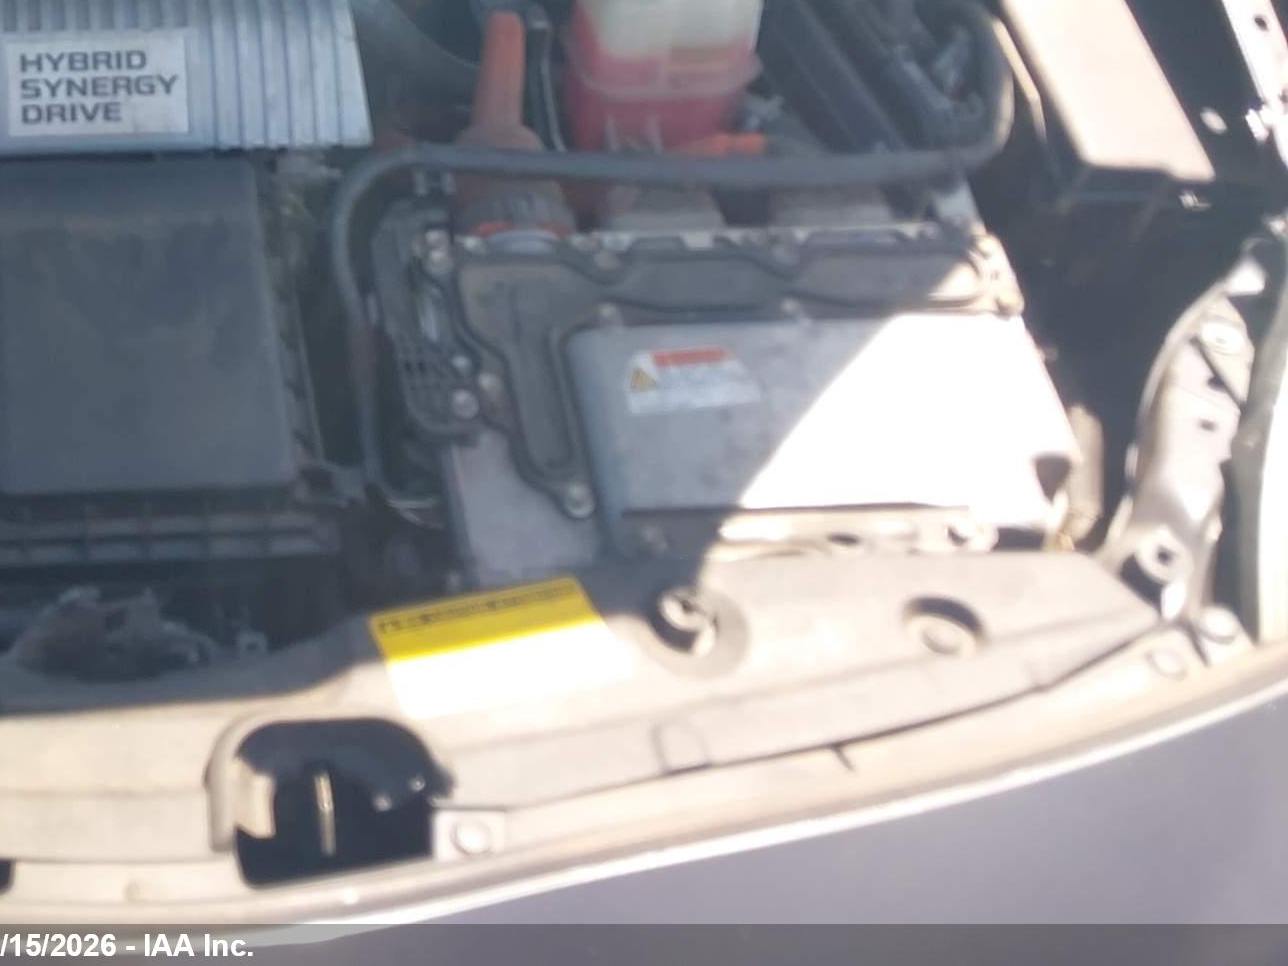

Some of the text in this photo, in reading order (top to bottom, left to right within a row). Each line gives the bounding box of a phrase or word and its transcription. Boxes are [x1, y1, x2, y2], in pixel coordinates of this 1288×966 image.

[20, 50, 147, 72] HYBRID
[20, 74, 178, 99] SYNERGY
[21, 102, 122, 125] DRIVE
